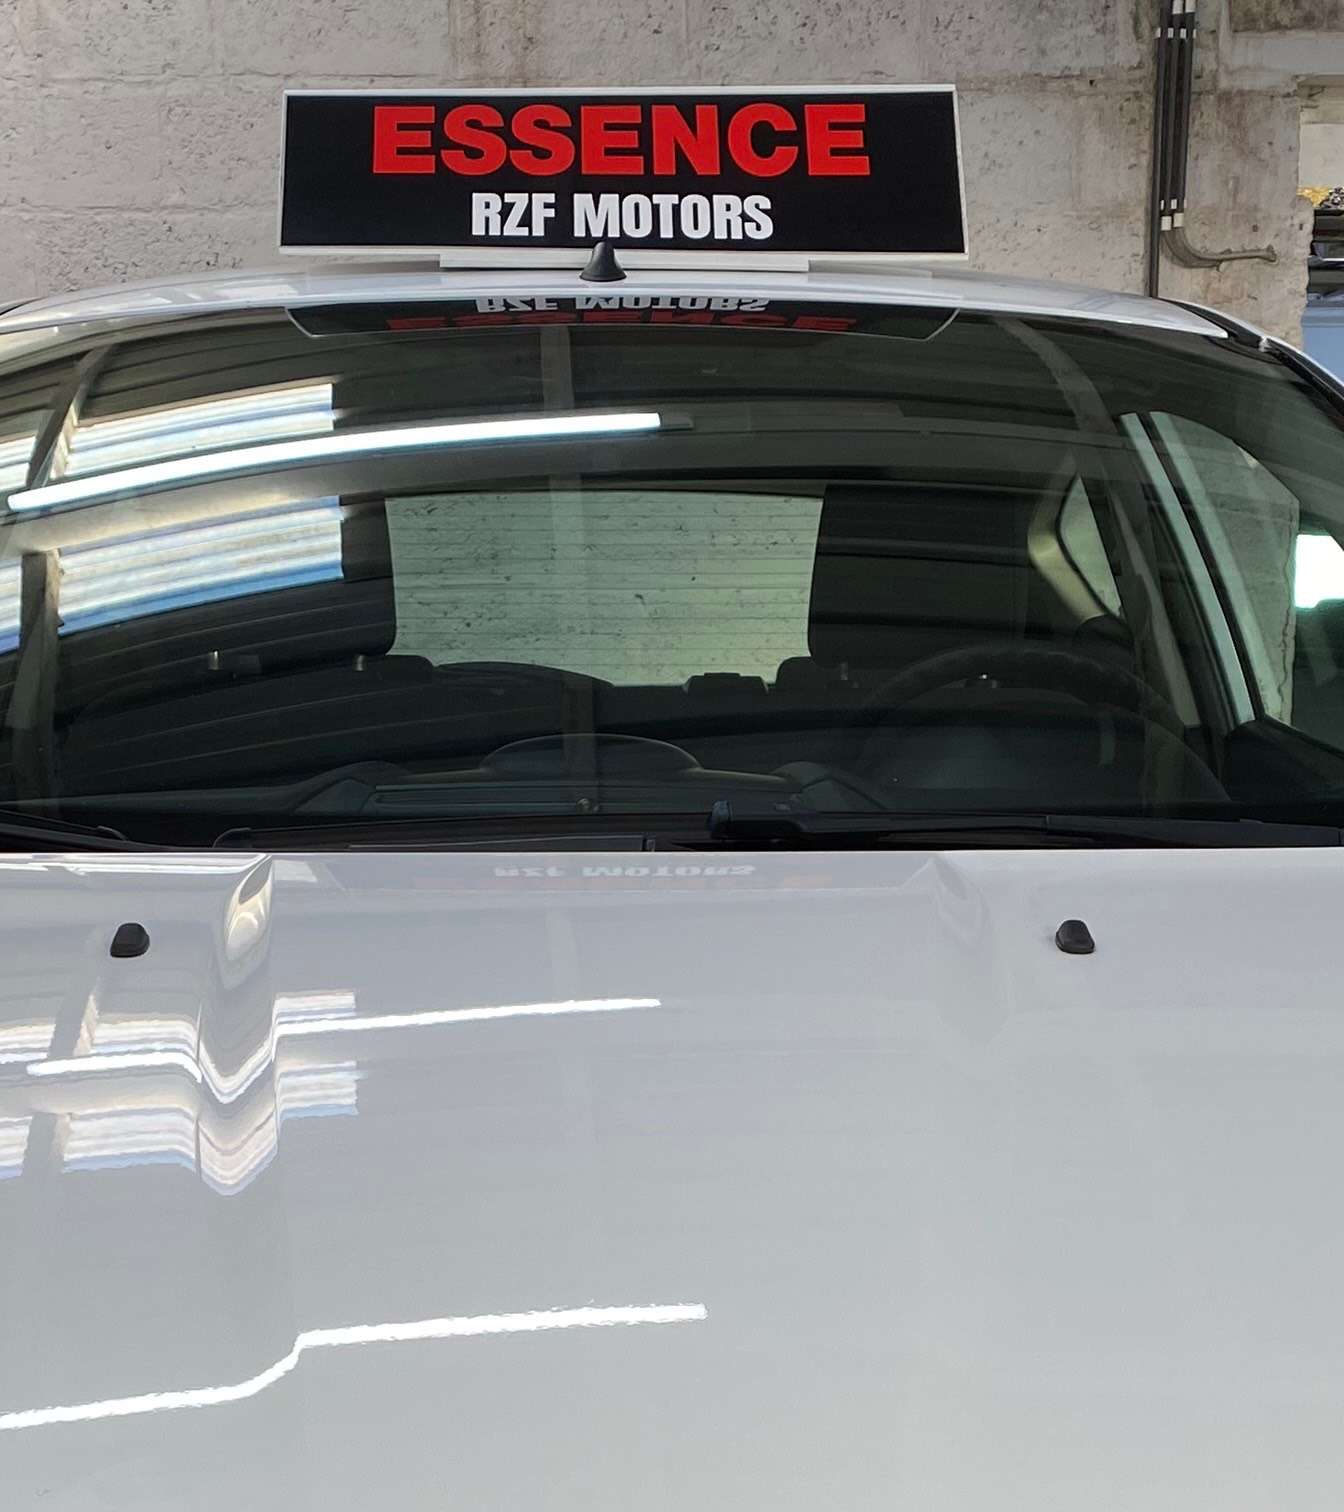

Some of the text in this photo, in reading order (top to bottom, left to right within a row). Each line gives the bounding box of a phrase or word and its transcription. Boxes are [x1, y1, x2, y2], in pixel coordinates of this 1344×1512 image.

[371, 102, 871, 177] ESSENCE
[471, 192, 774, 240] RZF MOTORS
